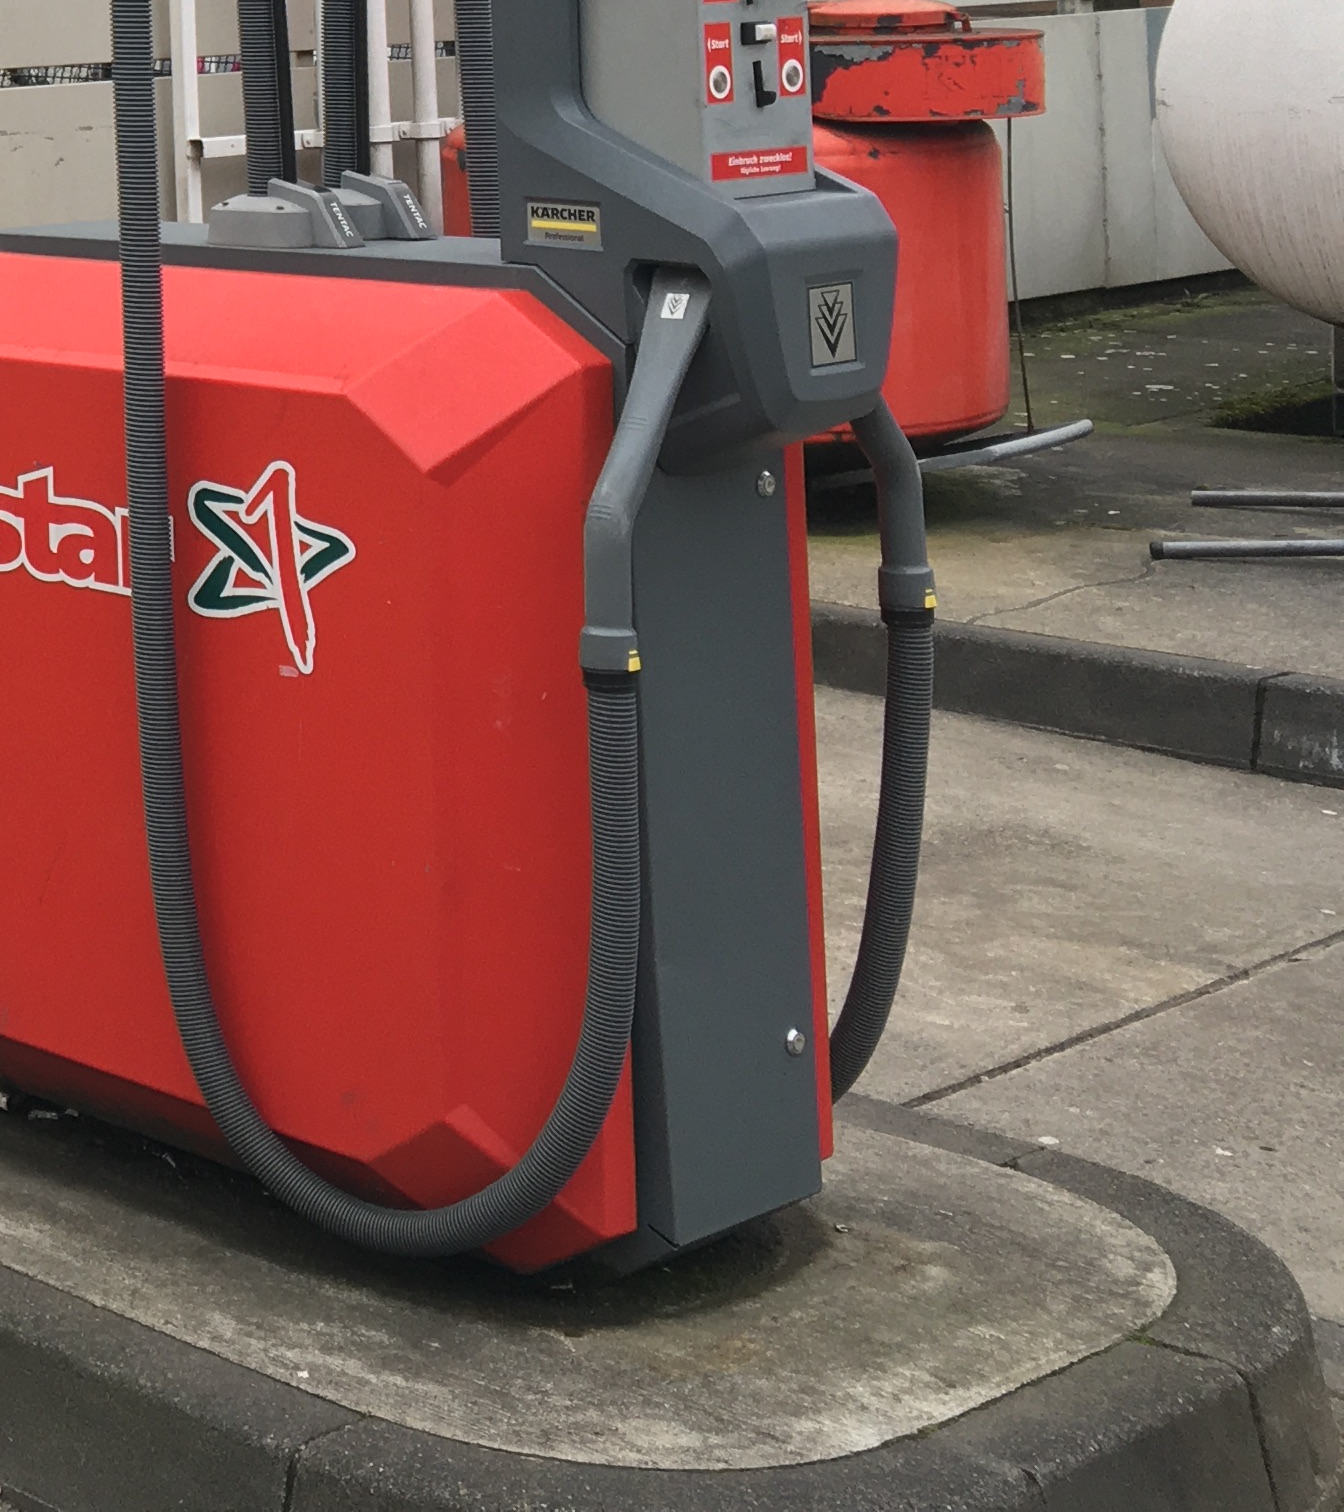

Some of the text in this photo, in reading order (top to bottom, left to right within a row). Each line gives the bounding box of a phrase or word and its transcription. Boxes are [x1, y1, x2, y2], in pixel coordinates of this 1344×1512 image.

[728, 154, 758, 167] Einbruch
[329, 201, 354, 239] TENTAC
[402, 193, 428, 229] TENTAC
